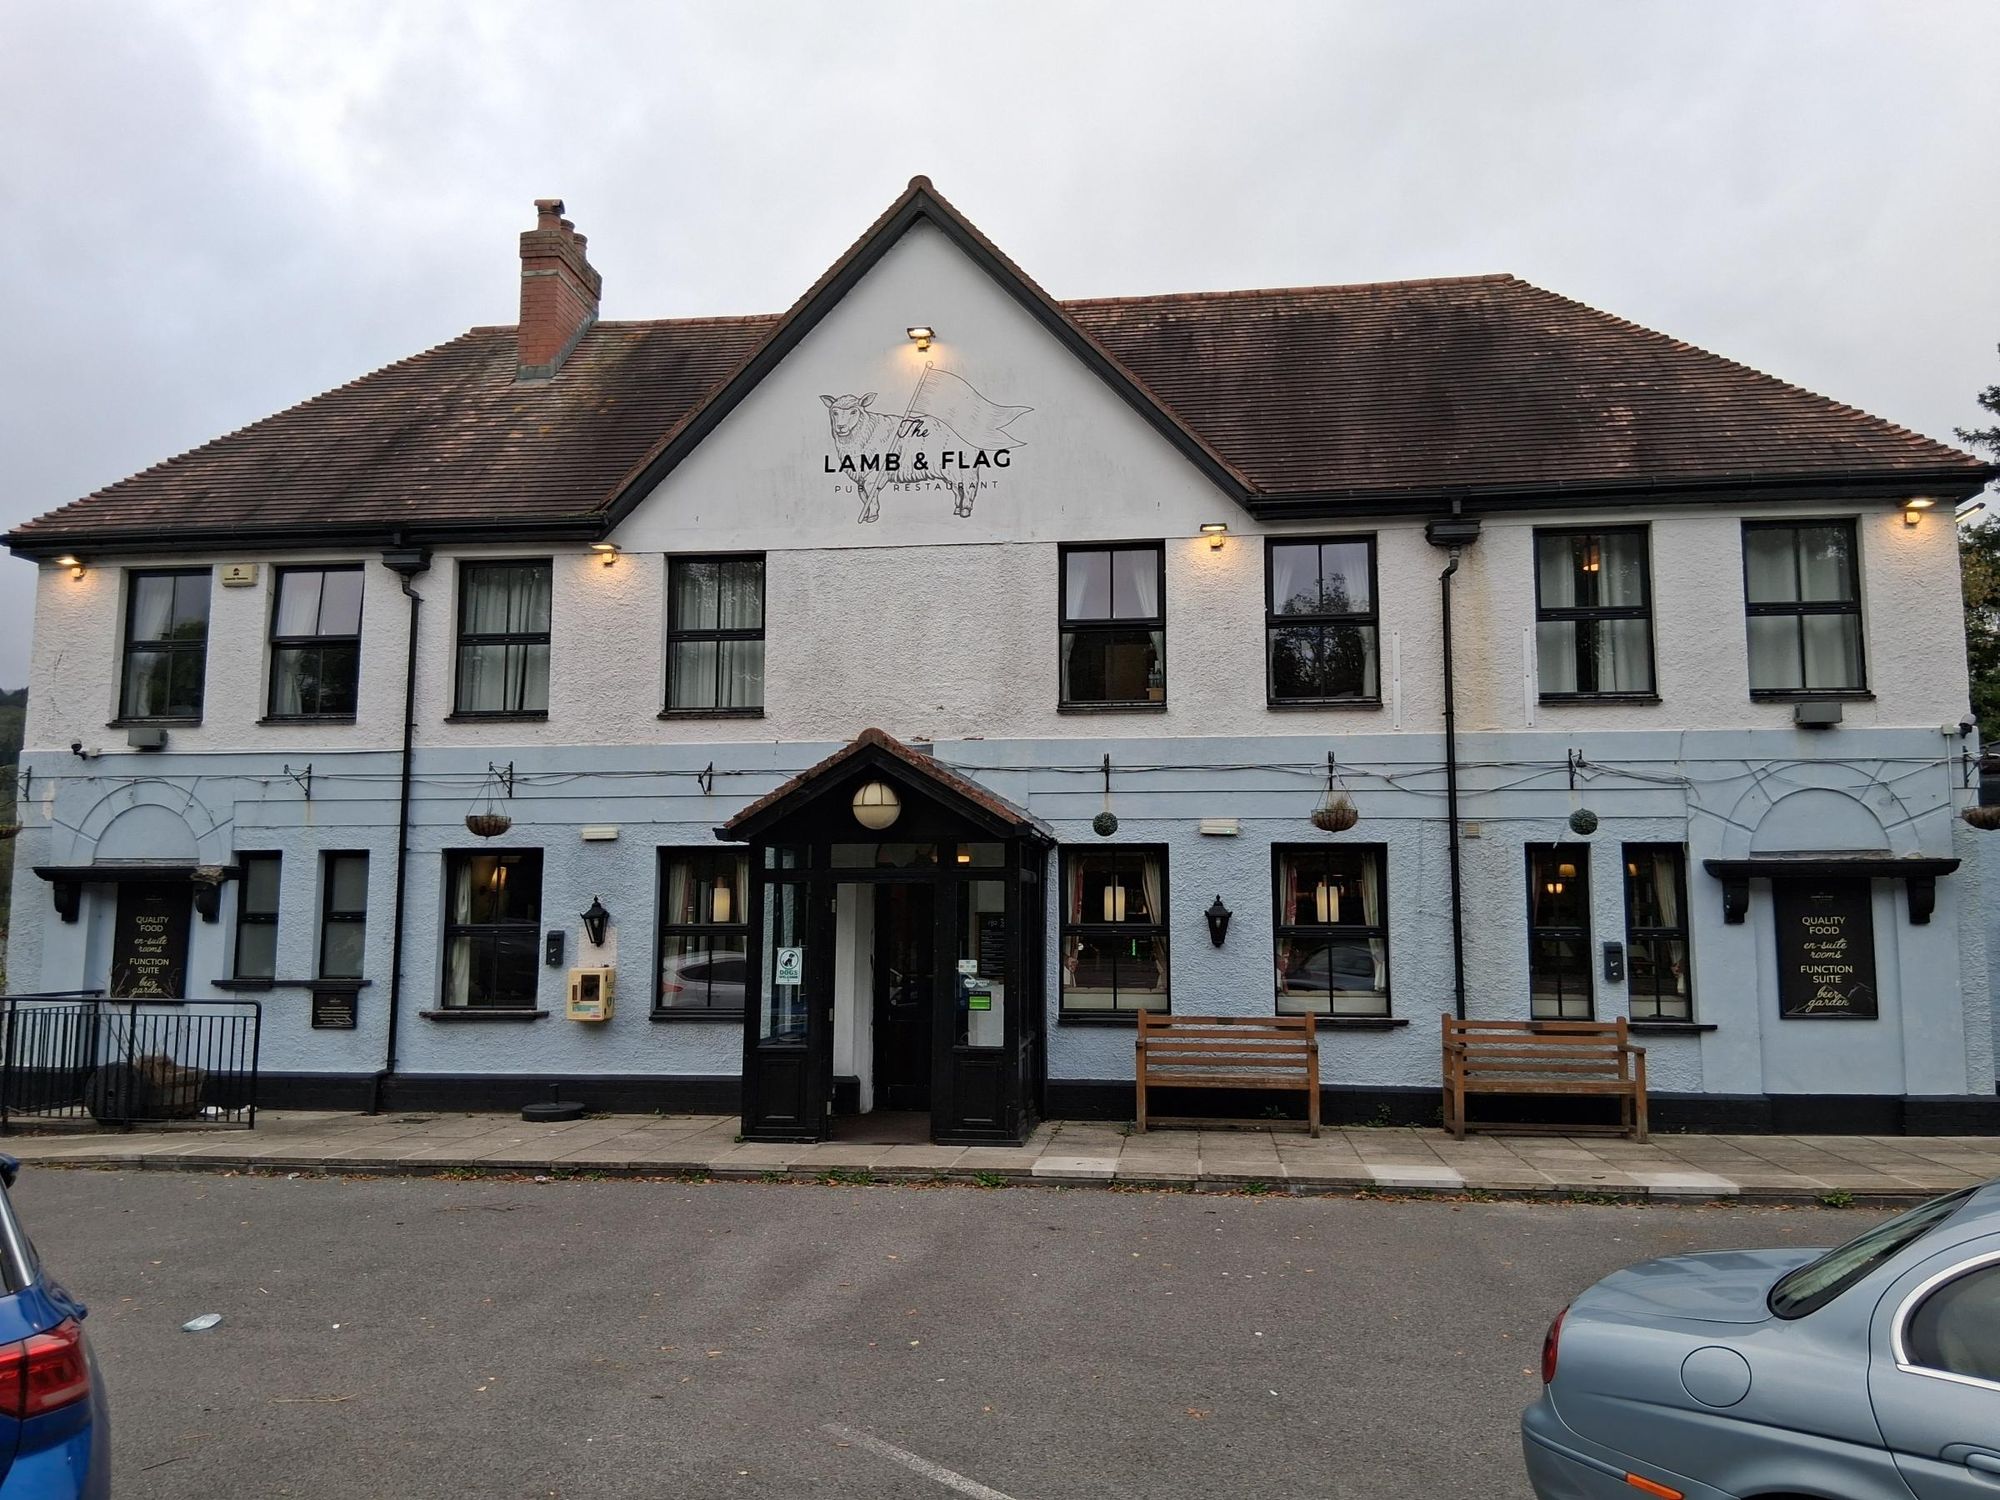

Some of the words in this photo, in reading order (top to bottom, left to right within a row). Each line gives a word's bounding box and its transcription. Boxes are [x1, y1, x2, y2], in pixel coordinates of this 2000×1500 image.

[897, 419, 930, 438] The
[824, 453, 901, 473] LAMB
[913, 452, 929, 470] &
[941, 449, 1011, 470] FLAG
[834, 485, 865, 494] PUB
[893, 480, 999, 492] RESTAURANT
[1802, 916, 1845, 925] QUALITY
[1809, 926, 1840, 935] FOOD
[134, 935, 168, 944] en-suite
[1803, 938, 1847, 949] en-suite
[1810, 950, 1842, 959] rooms
[129, 958, 170, 966] FUNCTION
[137, 967, 160, 975] SUITE
[1800, 965, 1853, 974] FUNCTION
[139, 977, 158, 987] beer
[1812, 975, 1842, 984] SUITE
[130, 986, 163, 998] garden
[1816, 985, 1841, 998] beer
[1805, 999, 1850, 1013] garden
